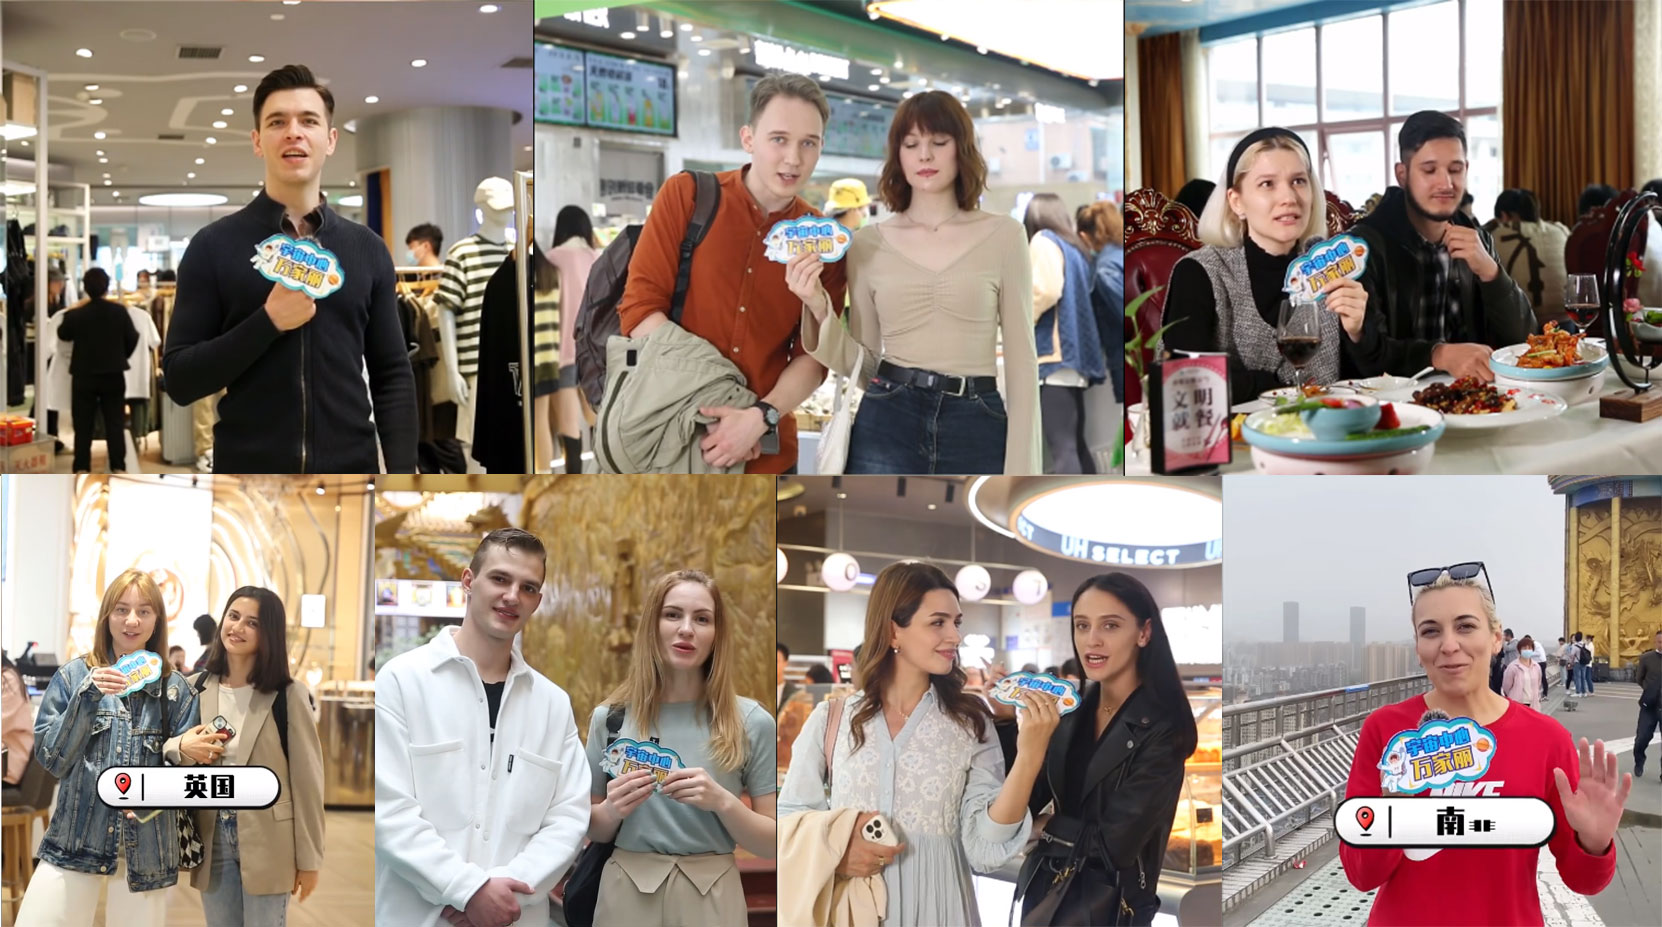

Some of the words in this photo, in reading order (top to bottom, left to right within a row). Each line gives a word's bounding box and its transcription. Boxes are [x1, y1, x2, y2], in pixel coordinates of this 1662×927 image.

[784, 224, 834, 239] 宇宙中心
[280, 243, 330, 272] 宇宙中心
[1300, 241, 1351, 276] 宇宙中心
[273, 256, 324, 289] 万家丽
[1172, 388, 1213, 412] 文明
[1172, 409, 1213, 432] 就餐
[1061, 535, 1089, 560] UH
[1091, 545, 1181, 566] SELECT
[120, 656, 147, 675] 宙中心
[1018, 677, 1066, 696] 宇宙中心
[1405, 727, 1471, 757] 宇宙中心
[625, 746, 672, 770] 宇宙中心
[1409, 745, 1475, 782] 万家丽
